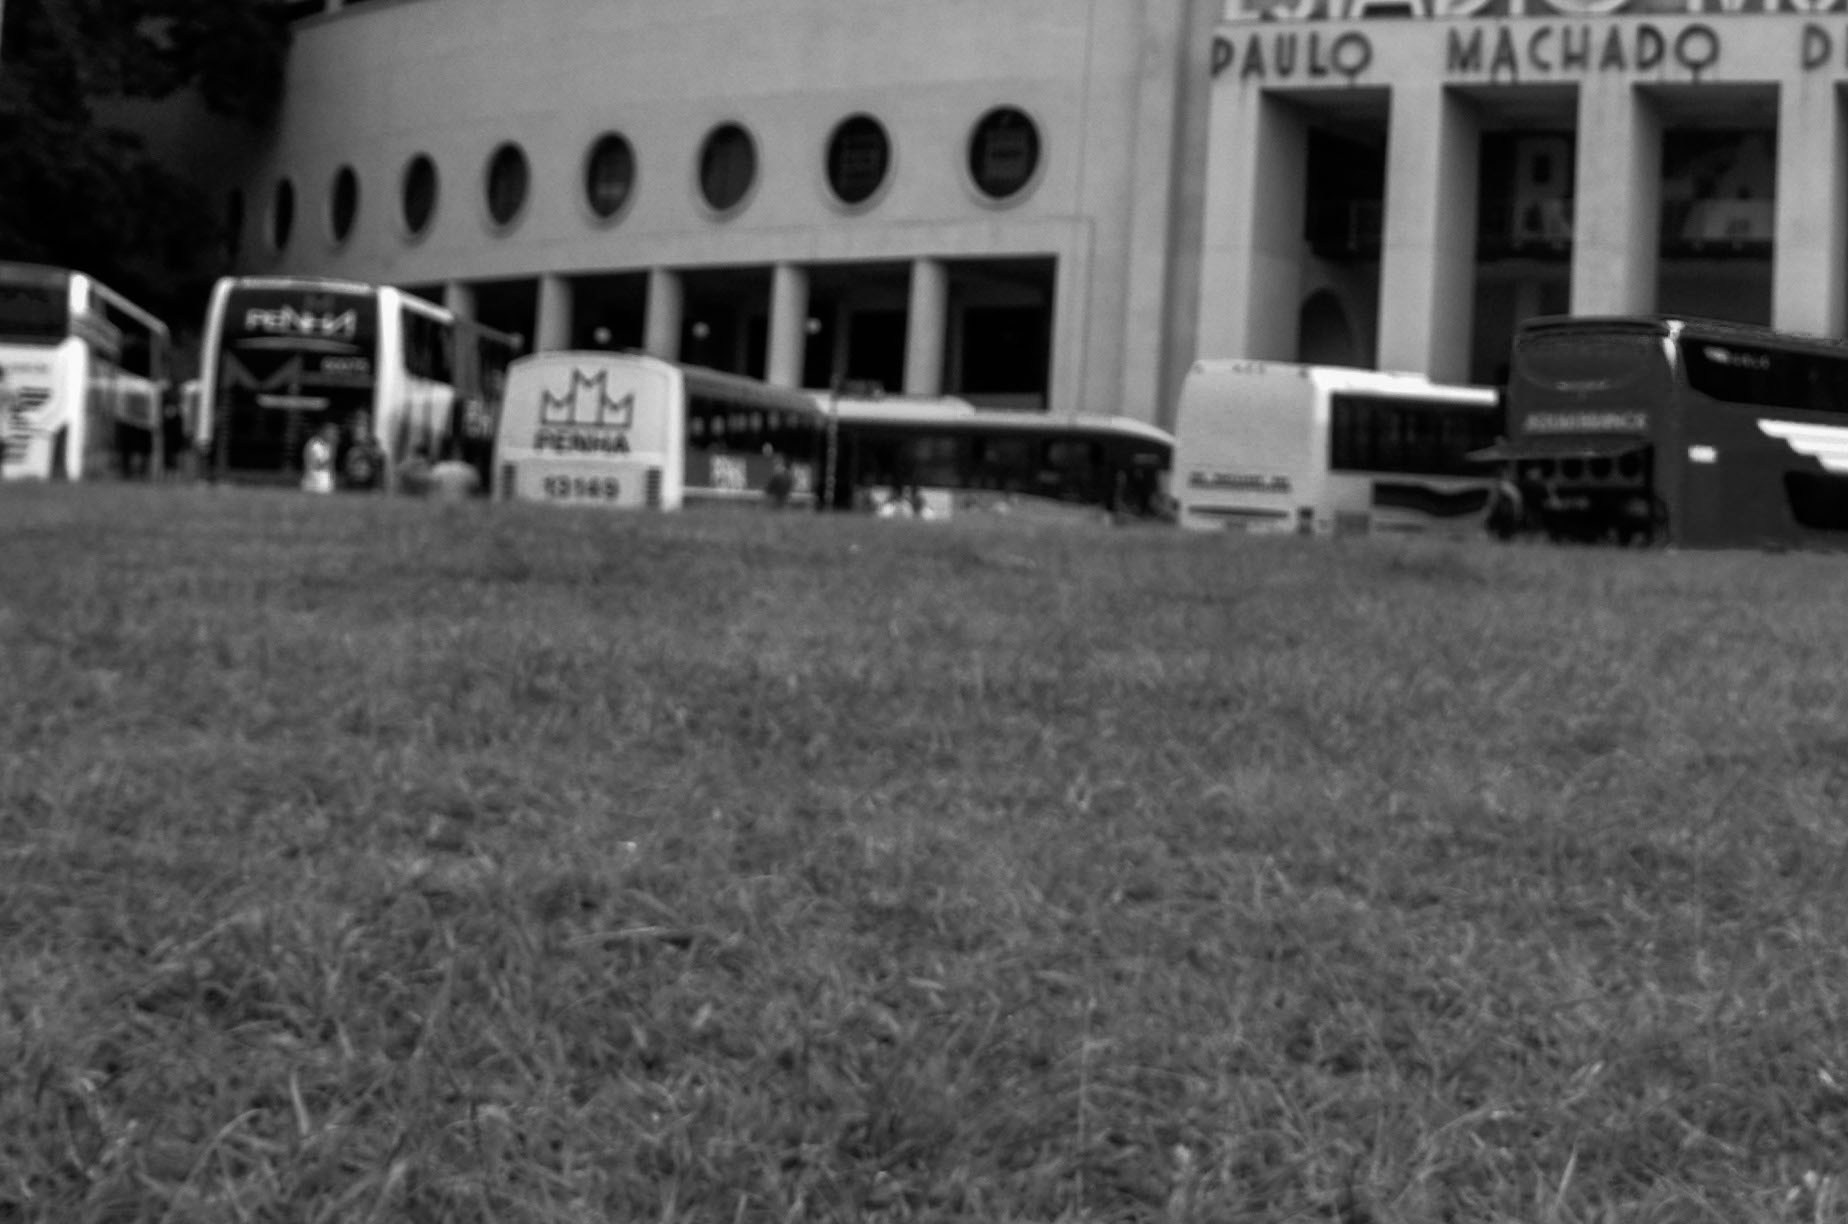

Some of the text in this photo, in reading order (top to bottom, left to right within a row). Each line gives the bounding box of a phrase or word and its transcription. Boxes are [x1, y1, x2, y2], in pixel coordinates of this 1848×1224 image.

[1210, 30, 1375, 78] PAULO
[1446, 23, 1722, 77] MACHADO
[244, 306, 359, 341] PENHA
[533, 427, 631, 453] PENHA
